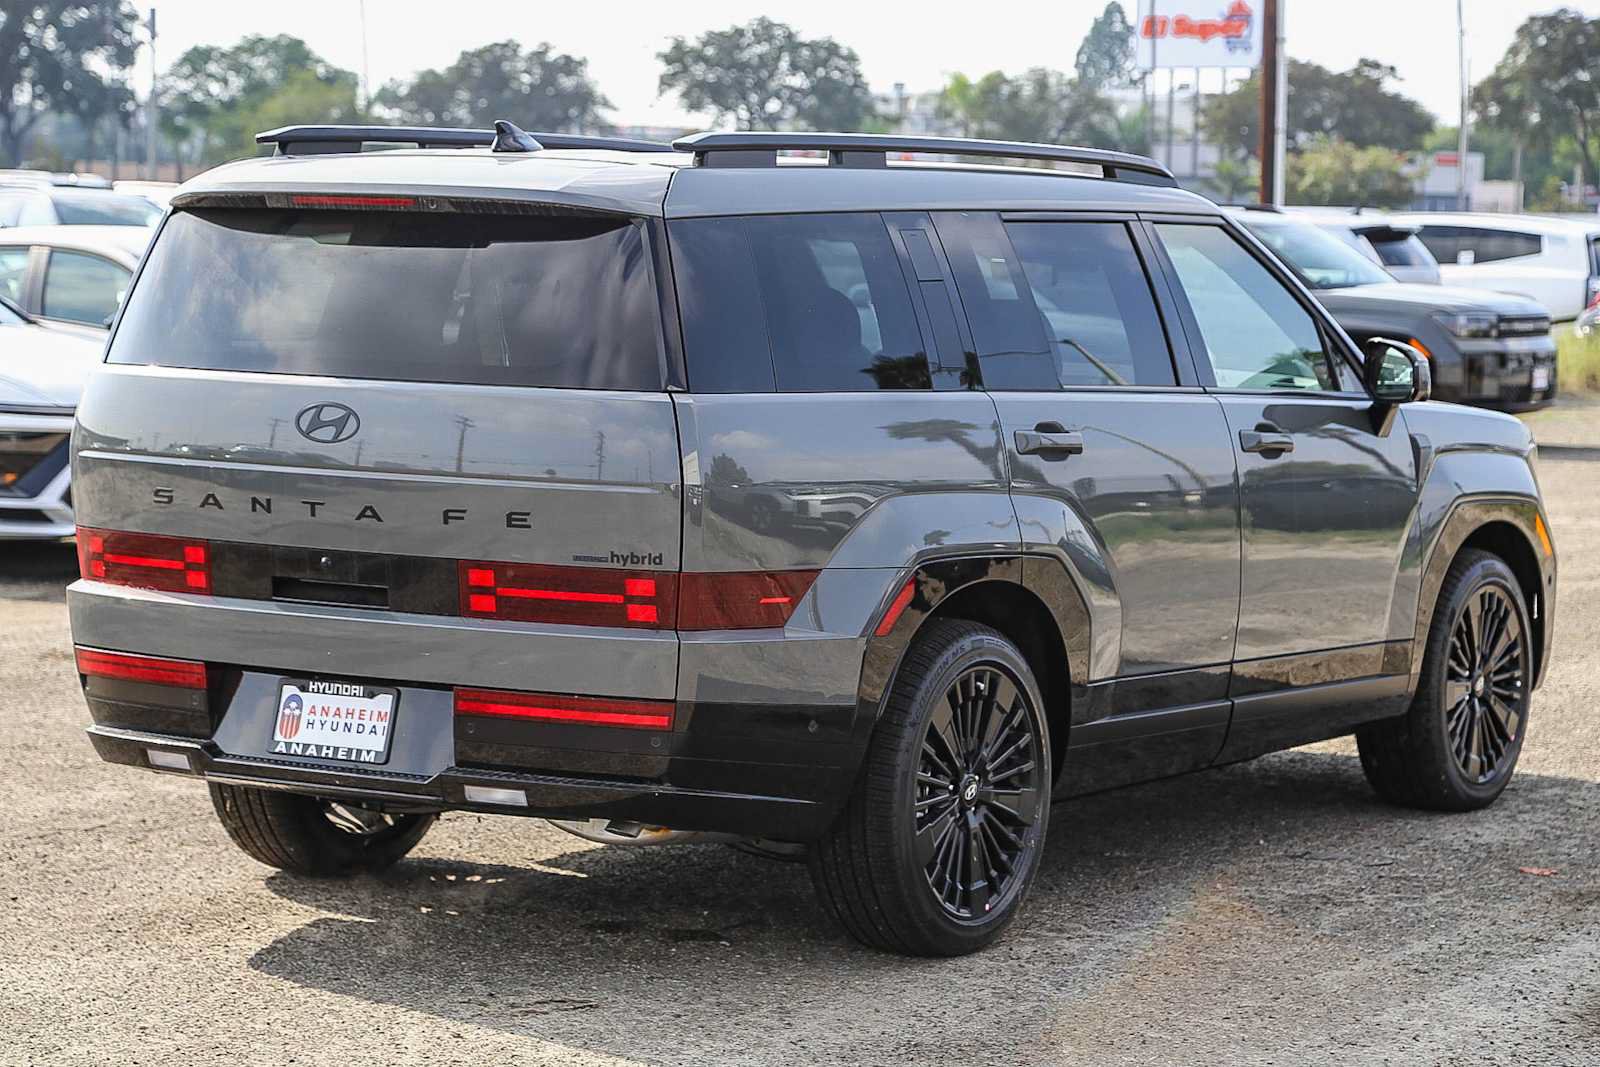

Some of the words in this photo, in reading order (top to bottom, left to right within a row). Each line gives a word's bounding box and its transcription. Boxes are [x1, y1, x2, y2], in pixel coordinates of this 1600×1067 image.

[152, 486, 384, 523] SANTA
[442, 508, 533, 529] FE
[609, 550, 663, 567] hybrid
[308, 681, 364, 697] HYUNDAI
[307, 704, 389, 723] ANAHEIM
[305, 718, 387, 737] HYUNDAI
[274, 741, 376, 763] ANAHEIM
